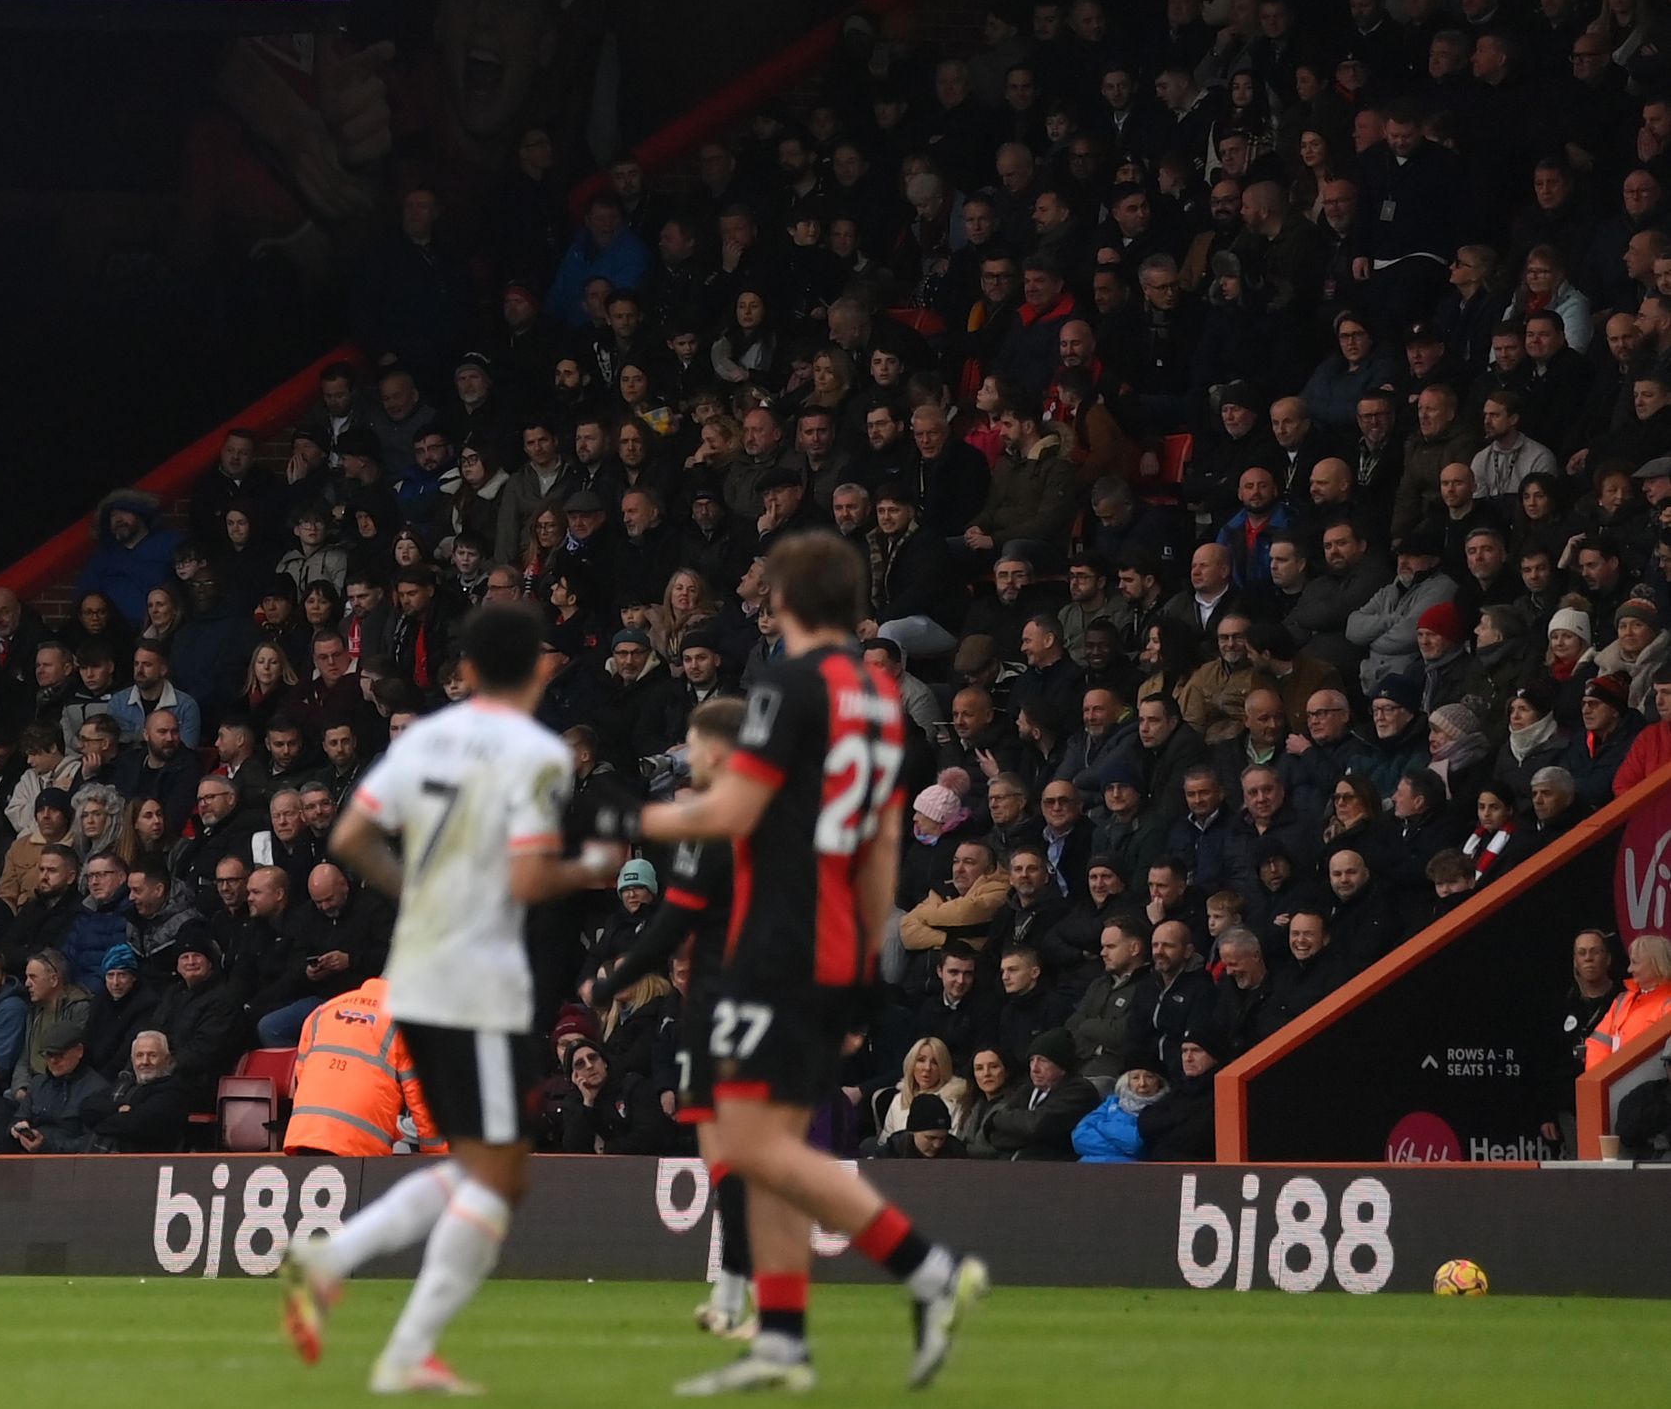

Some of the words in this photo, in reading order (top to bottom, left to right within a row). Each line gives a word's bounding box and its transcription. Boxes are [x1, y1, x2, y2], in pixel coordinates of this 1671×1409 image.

[813, 731, 906, 855] 27
[415, 777, 461, 888] 7
[709, 998, 774, 1060] 27
[1447, 1048, 1485, 1061] ROWS
[1487, 1049, 1497, 1060] A
[1506, 1048, 1514, 1060] R
[1447, 1064, 1485, 1076] SEATS
[1505, 1064, 1521, 1076] 33
